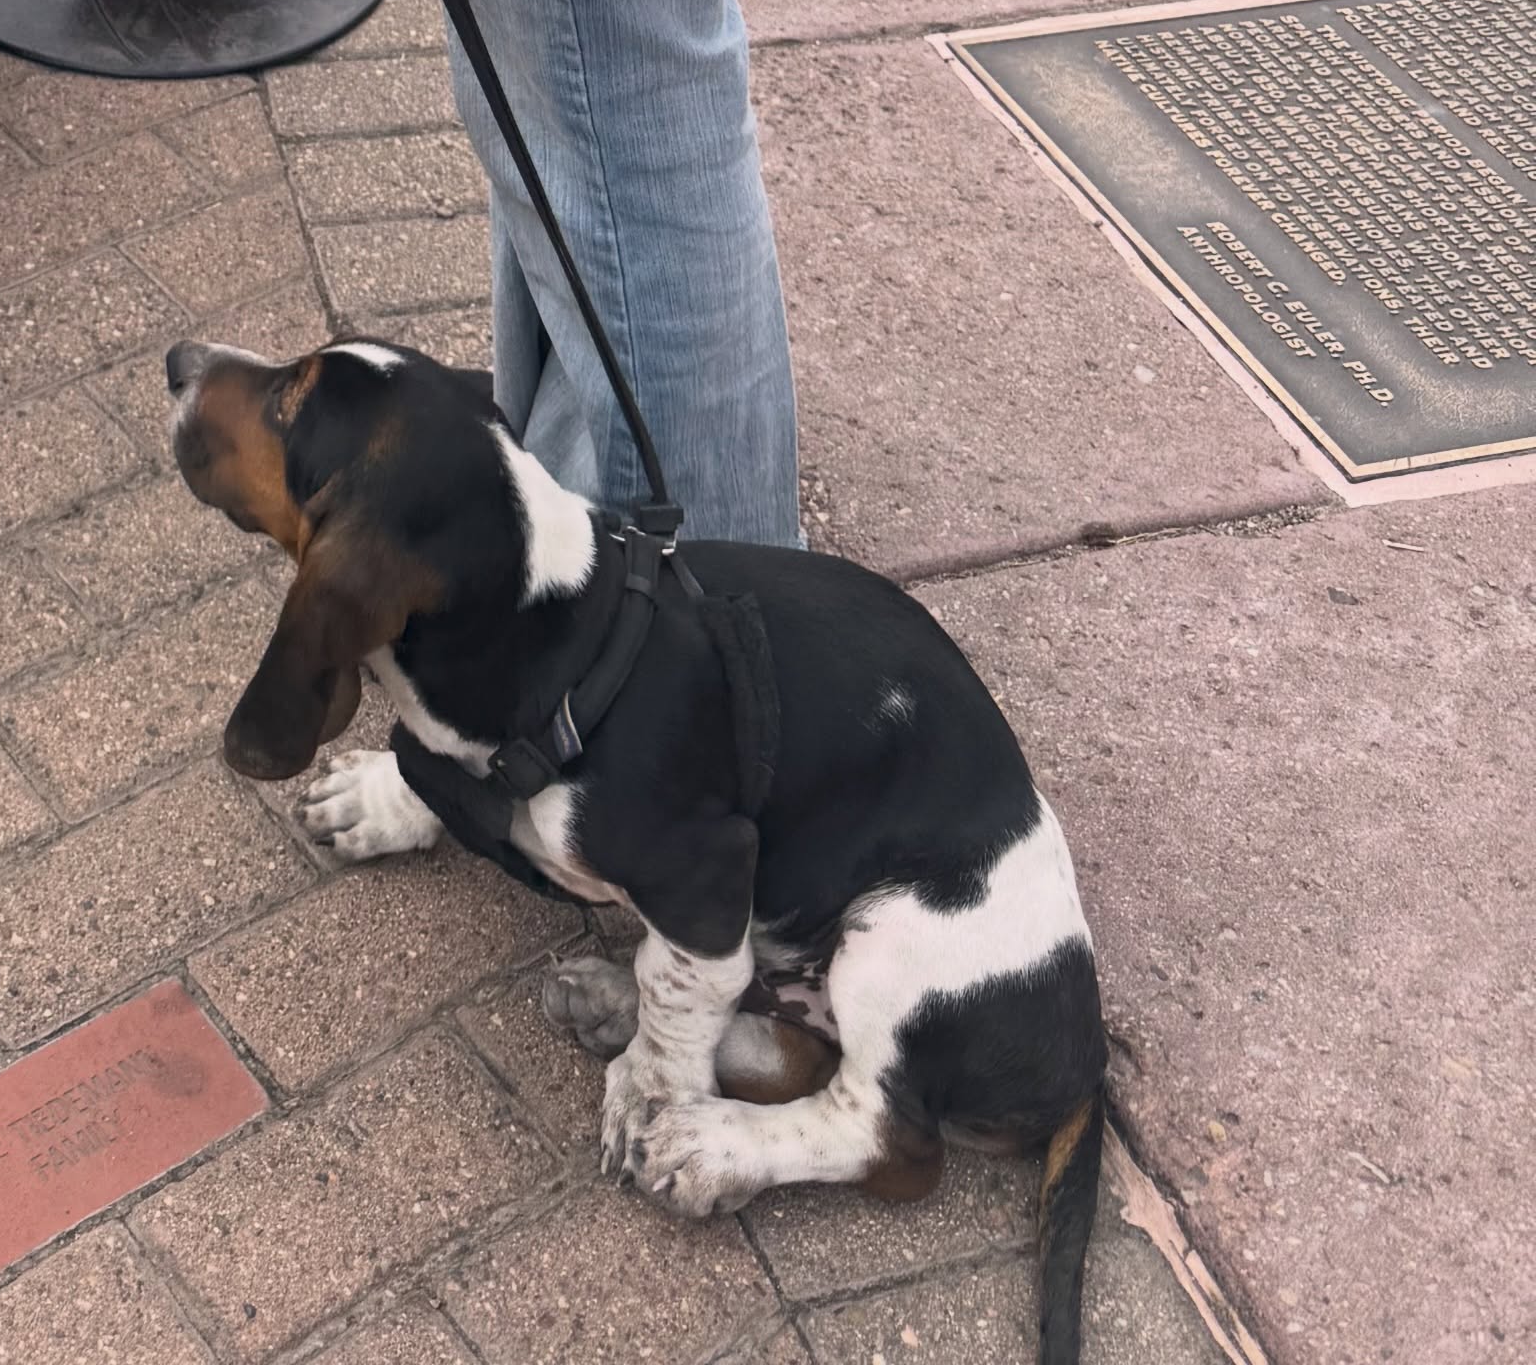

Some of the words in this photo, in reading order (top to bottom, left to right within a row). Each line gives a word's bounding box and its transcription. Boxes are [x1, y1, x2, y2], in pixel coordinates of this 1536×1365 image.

[1279, 14, 1347, 65] SPANISH
[1338, 67, 1428, 139] EXPLORERS
[1420, 141, 1462, 169] AND
[1335, 6, 1410, 68] POLITICAL
[1406, 68, 1453, 97] LIFE
[1441, 99, 1482, 126] AND
[1355, 4, 1416, 52] PLANTS.
[1415, 52, 1461, 84] THEY
[1453, 87, 1503, 121] EACH
[1495, 123, 1536, 151] HAD
[1374, 1, 1404, 18] AS
[1396, 18, 1460, 66] HUNTED
[1455, 67, 1505, 102] GAME
[1447, 21, 1485, 46] THE
[1479, 45, 1535, 87] VERDE
[1450, 44, 1516, 92] FARMED
[1483, 11, 1536, 55] TRIBES
[1496, 4, 1533, 29] THE
[1094, 39, 1146, 82] NATIVE
[1139, 82, 1213, 148] CULTURES
[1205, 149, 1276, 210] FOREVER
[1270, 211, 1346, 285] CHANGED.
[1115, 36, 1197, 106] ULTIMATELY
[1189, 108, 1250, 160] FORCED
[1243, 161, 1274, 181] ON
[1267, 182, 1294, 202] TO
[1287, 204, 1404, 313] RESERVATIONS,
[1402, 315, 1460, 364] THEIR
[1135, 33, 1203, 89] HISTORIC
[1196, 90, 1251, 135] TRIBES
[1244, 137, 1292, 175] WERE
[1284, 176, 1375, 252] MILITARILY
[1367, 256, 1454, 331] DEFEATED
[1448, 335, 1494, 368] AND
[1156, 30, 1229, 91] REMAINED
[1221, 92, 1248, 108] IN
[1240, 109, 1290, 148] THEIR
[1282, 150, 1361, 215] MESA-TOP
[1353, 218, 1415, 272] HOMES,
[1413, 273, 1455, 304] THE
[1448, 306, 1511, 358] OTHER
[1177, 26, 1211, 52] THE
[1202, 53, 1246, 85] AREA
[1238, 87, 1277, 114] AND
[1270, 114, 1345, 176] WARFARE
[1337, 178, 1404, 237] ENSUED.
[1403, 240, 1466, 289] WHILE
[1459, 290, 1503, 322] THE
[1196, 25, 1251, 65] ABOUT
[1244, 67, 1287, 103] 1850,
[1283, 105, 1427, 230] ANGLO-AMERICANS
[1422, 232, 1473, 271] TOOK
[1464, 273, 1517, 313] OVER
[1217, 22, 1303, 90] NORTHEAST
[1295, 92, 1325, 110] OF
[1315, 112, 1407, 185] FLAGSTAFF
[1399, 188, 1478, 249] SHORTLY
[1238, 19, 1304, 75] PEOPLES.
[1302, 75, 1338, 102] THE
[1330, 103, 1392, 152] NAVAJO
[1387, 153, 1437, 191] CAME
[1430, 191, 1458, 211] TO
[1453, 212, 1494, 242] THE
[1257, 17, 1301, 48] AREA
[1294, 50, 1332, 76] AND
[1325, 77, 1397, 132] ALTERED
[1390, 132, 1429, 160] THE
[1419, 161, 1467, 193] LIFE
[1457, 193, 1508, 232] WAYS
[1502, 234, 1535, 254] OF
[1315, 23, 1351, 49] THE
[1343, 50, 1422, 107] HISTORIC
[1410, 108, 1472, 156] PERIOD
[1466, 157, 1528, 204] BEGAN
[1177, 225, 1316, 356] ANTHROPOLOGIST
[1205, 220, 1274, 277] ROBERT
[1265, 280, 1290, 298] C.
[1283, 300, 1345, 357] EULER,
[1342, 360, 1394, 406] PH.D.
[27, 1107, 128, 1183] FAMILY
